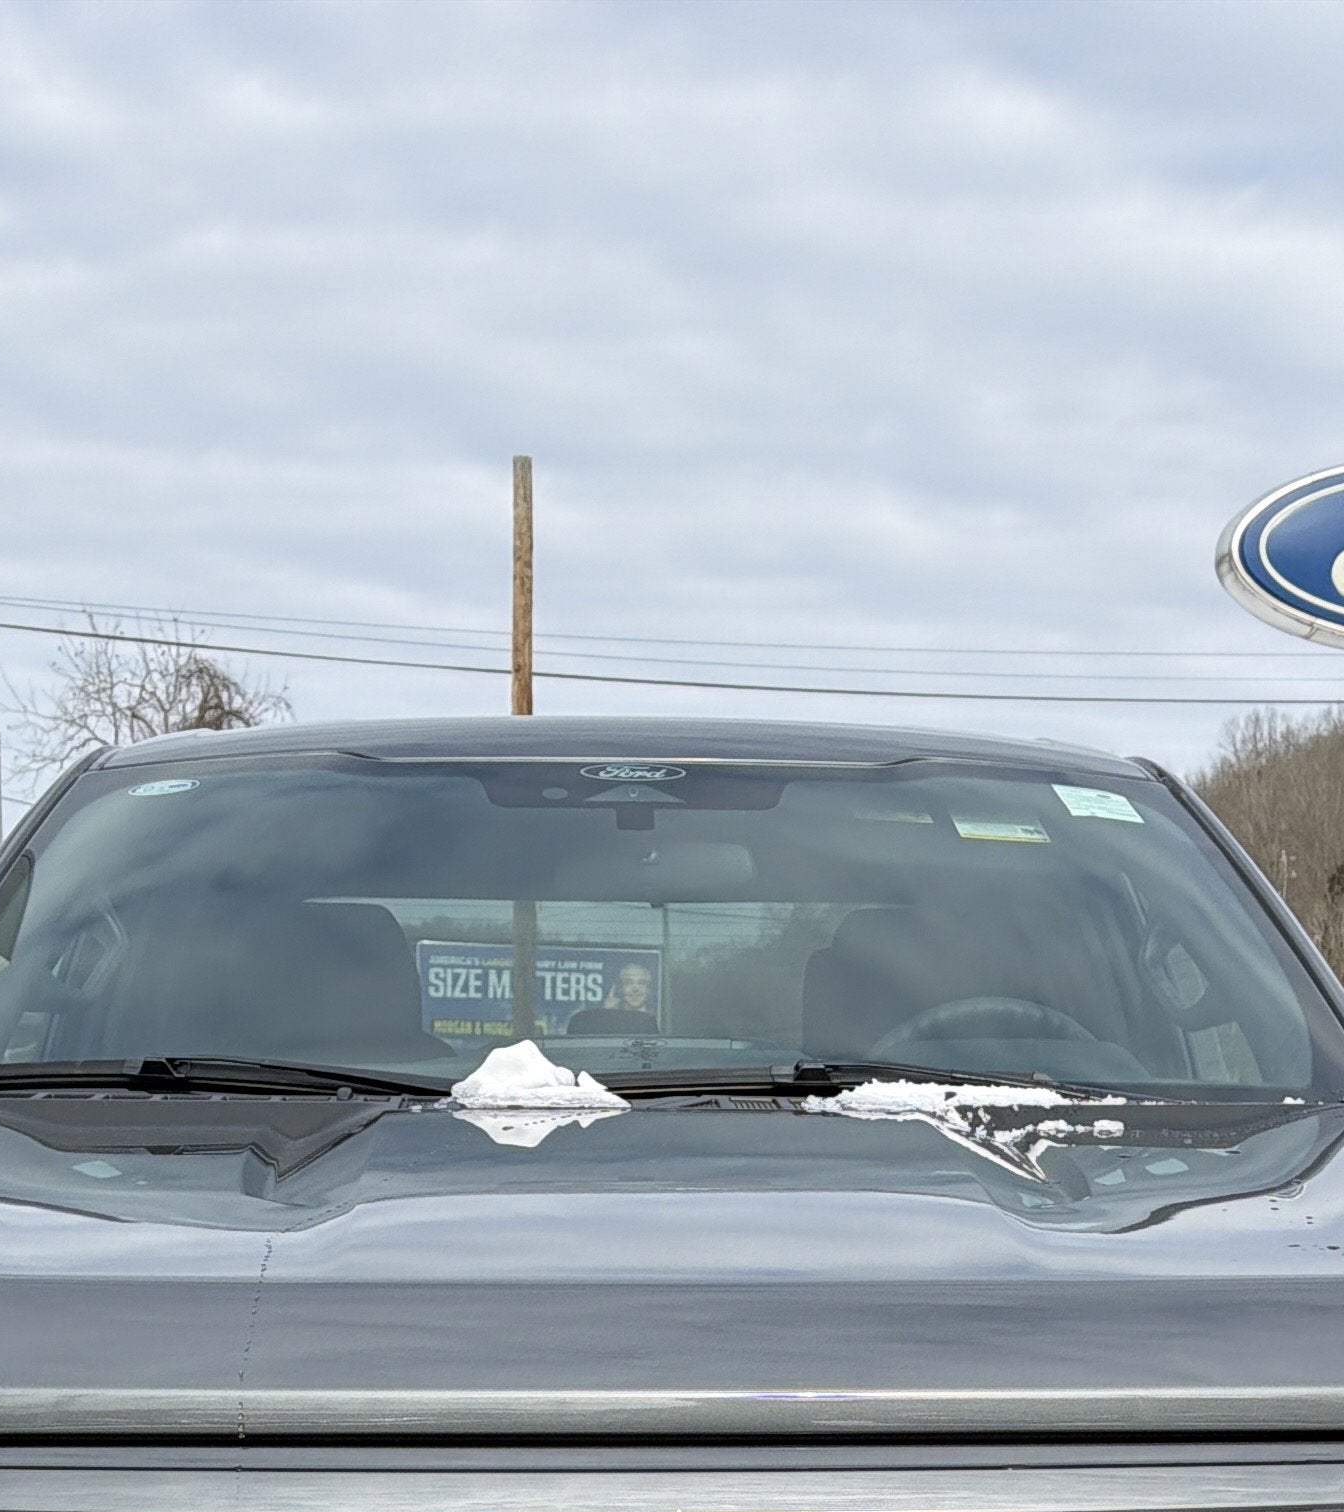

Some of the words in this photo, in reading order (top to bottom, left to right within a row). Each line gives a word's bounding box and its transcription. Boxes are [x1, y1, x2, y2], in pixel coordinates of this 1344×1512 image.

[600, 765, 667, 778] Ford
[428, 967, 483, 998] SIZE
[487, 969, 603, 1002] MTERS
